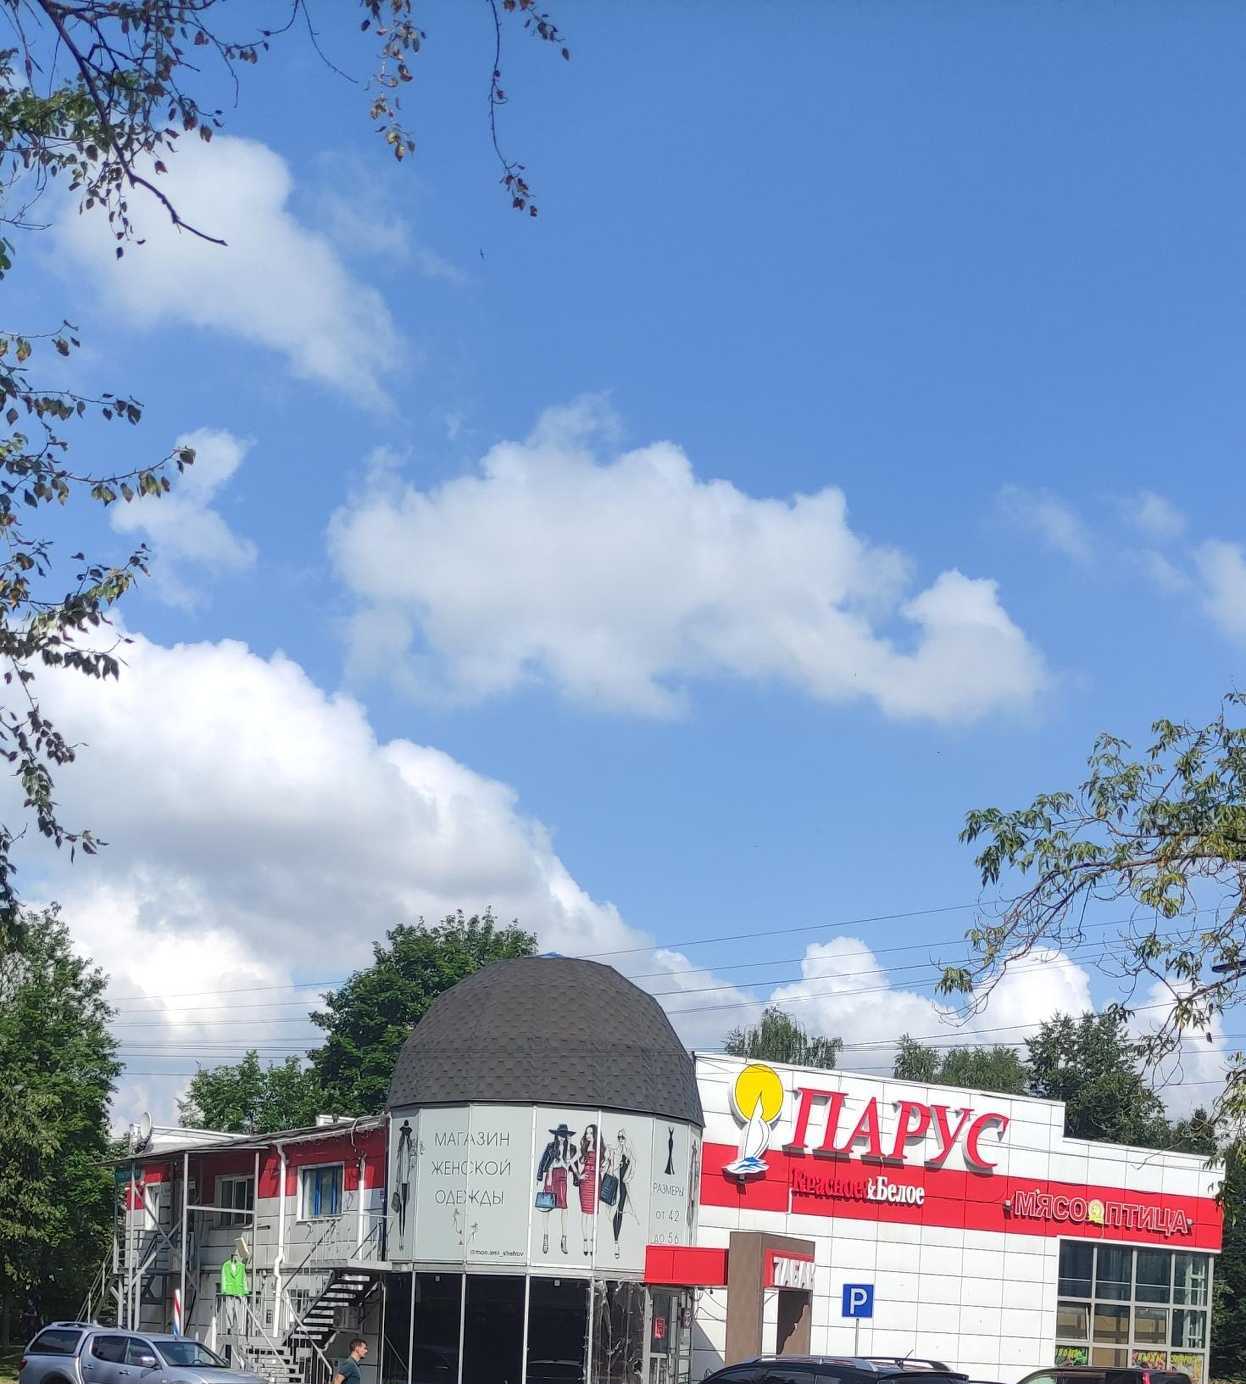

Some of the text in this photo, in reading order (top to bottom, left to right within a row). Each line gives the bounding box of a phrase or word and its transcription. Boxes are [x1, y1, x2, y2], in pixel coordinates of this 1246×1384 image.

[787, 1086, 1010, 1170] ПАРУС
[434, 1131, 510, 1147] МАГАЗИН
[431, 1159, 511, 1176] ЖЕНСКОЙ
[434, 1189, 504, 1206] ОДЕЖДЫ
[653, 1181, 684, 1197] РАЗМЕРЫ
[669, 1210, 680, 1222] 42
[1014, 1190, 1188, 1236] МЯСО ПТИЦА
[668, 1231, 679, 1244] 56
[850, 1288, 867, 1315] P
